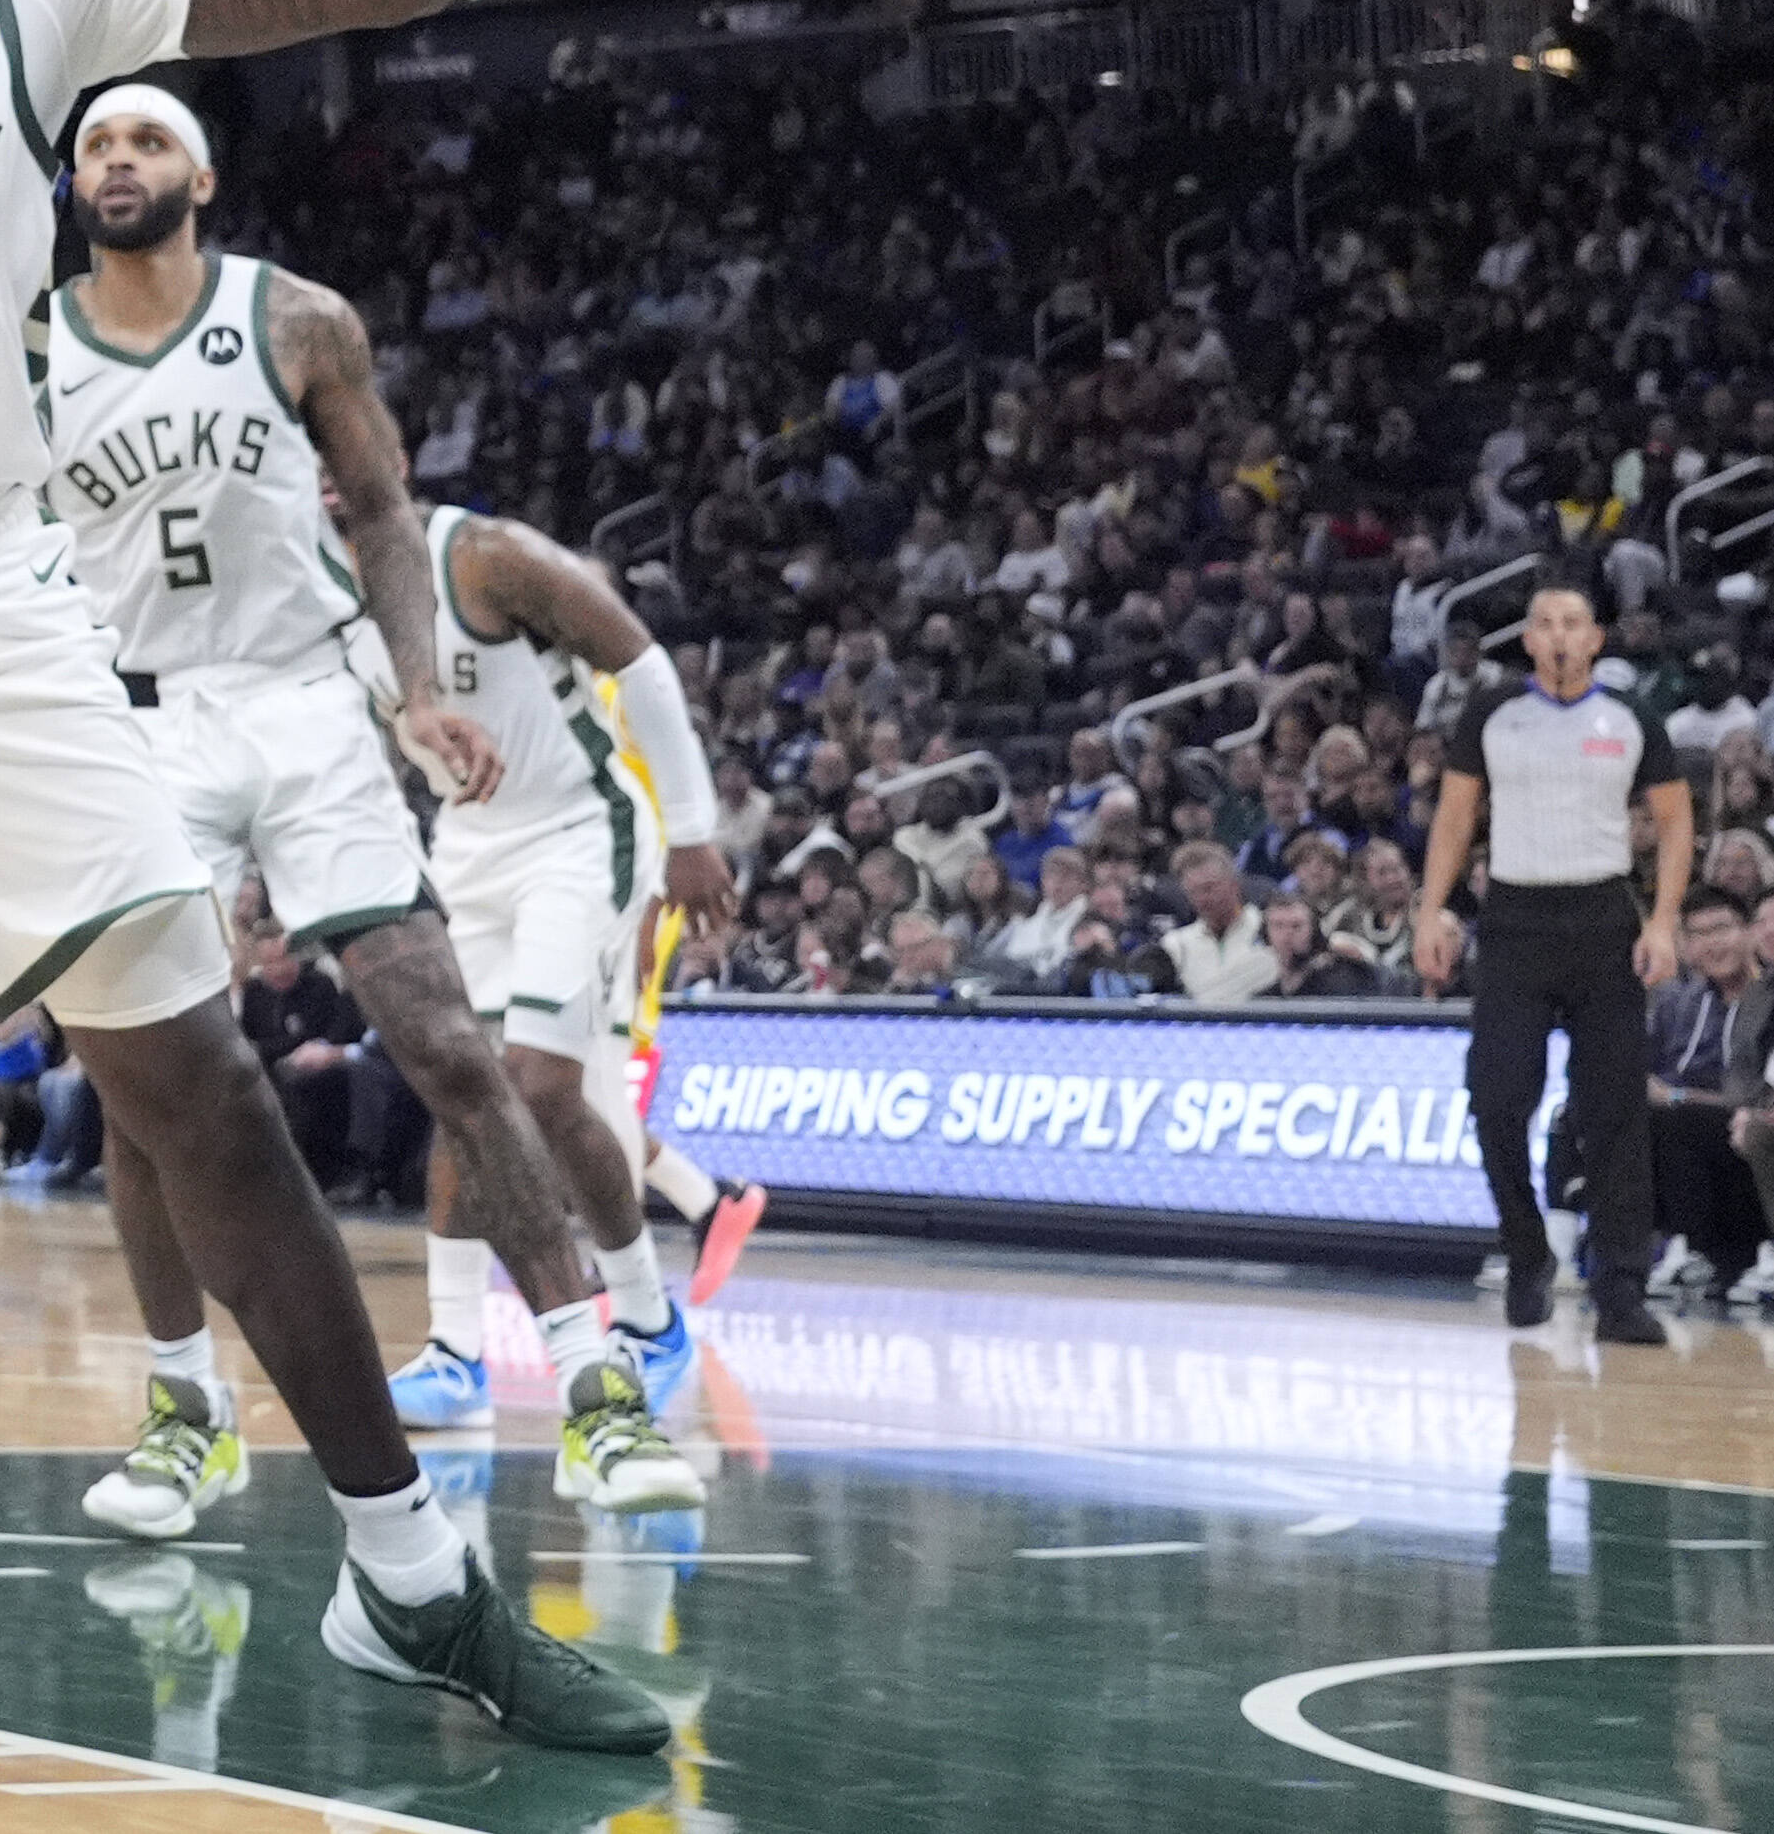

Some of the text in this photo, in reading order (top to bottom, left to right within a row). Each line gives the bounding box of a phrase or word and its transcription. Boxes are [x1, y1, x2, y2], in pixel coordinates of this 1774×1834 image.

[65, 412, 271, 511] BUCKS
[157, 507, 212, 590] 5
[674, 1062, 931, 1142] SHIPPING
[941, 1071, 1165, 1152] SUPPLY
